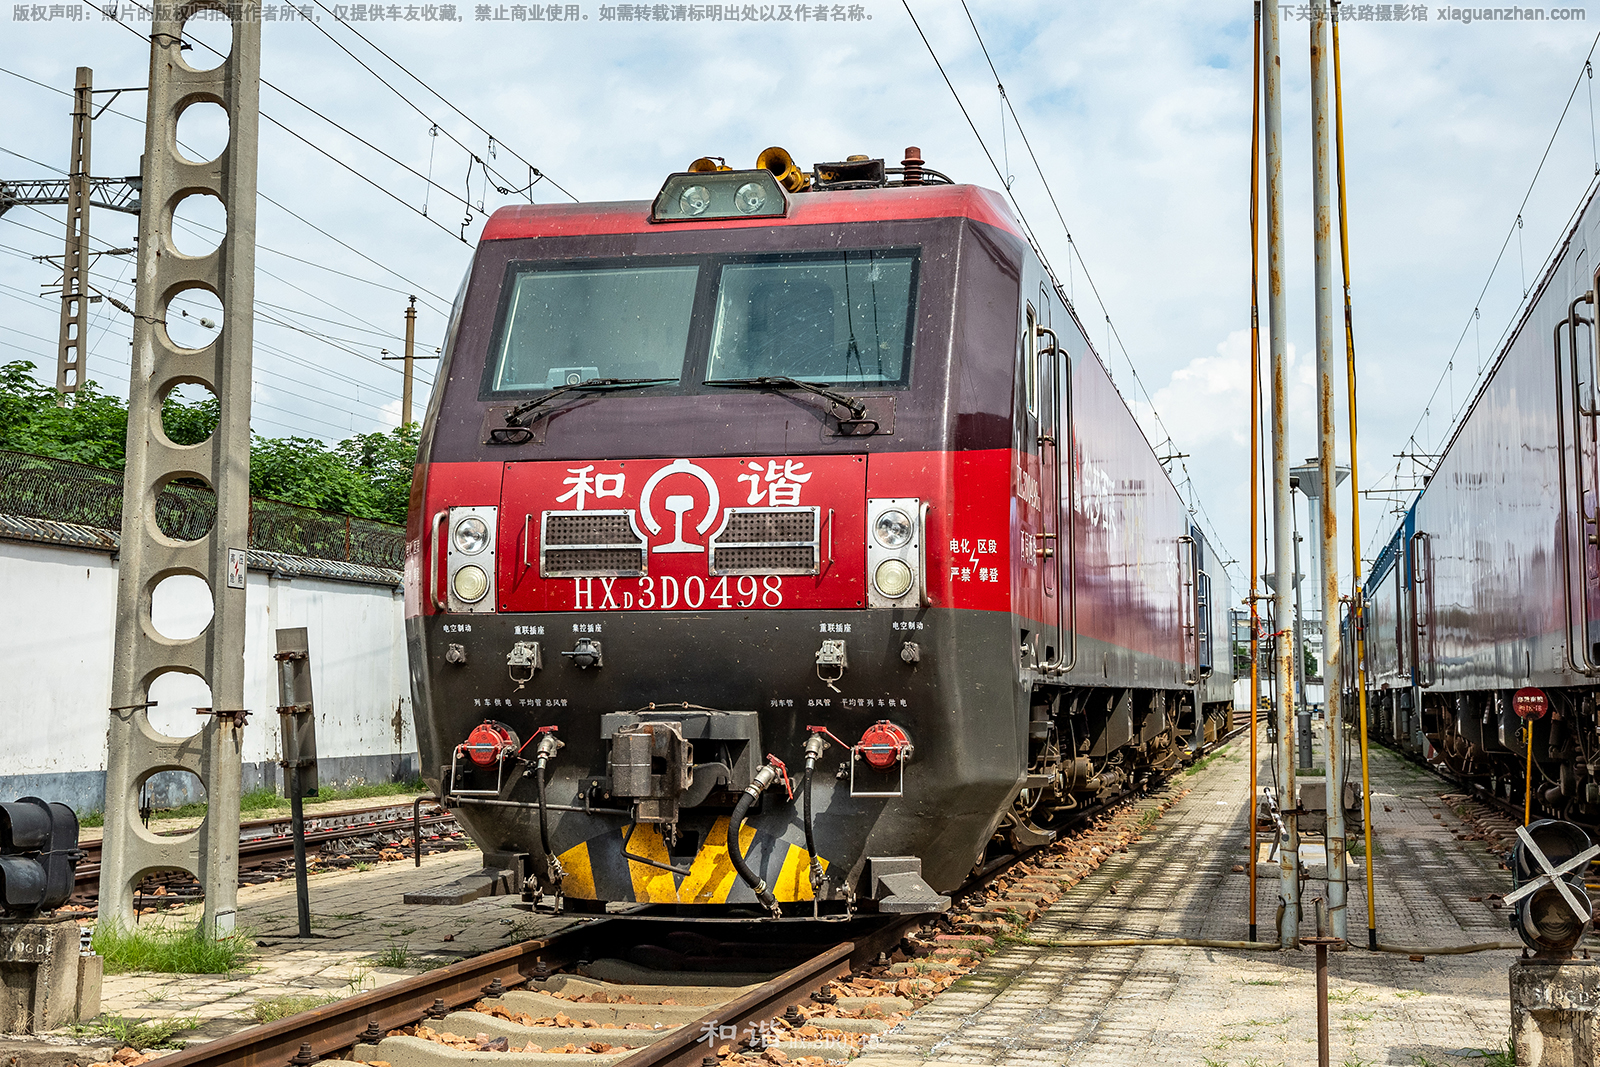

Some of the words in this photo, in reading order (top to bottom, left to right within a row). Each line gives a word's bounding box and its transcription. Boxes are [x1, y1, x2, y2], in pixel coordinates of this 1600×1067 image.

[555, 464, 626, 511] 和
[737, 459, 812, 507] 谐
[950, 538, 971, 553] 电化
[978, 538, 997, 553] 区段
[950, 567, 971, 582] 严禁
[979, 567, 998, 582] 攀登
[573, 575, 783, 610] HXD3D0498
[442, 624, 472, 633] 电空制动
[514, 625, 545, 635] 重联插座
[819, 622, 852, 633] 重联插座
[892, 621, 924, 631] 电空制动
[519, 698, 541, 707] 平均管
[545, 698, 568, 707] 总风管
[770, 699, 794, 708] 列车管
[807, 699, 831, 707] 总风管
